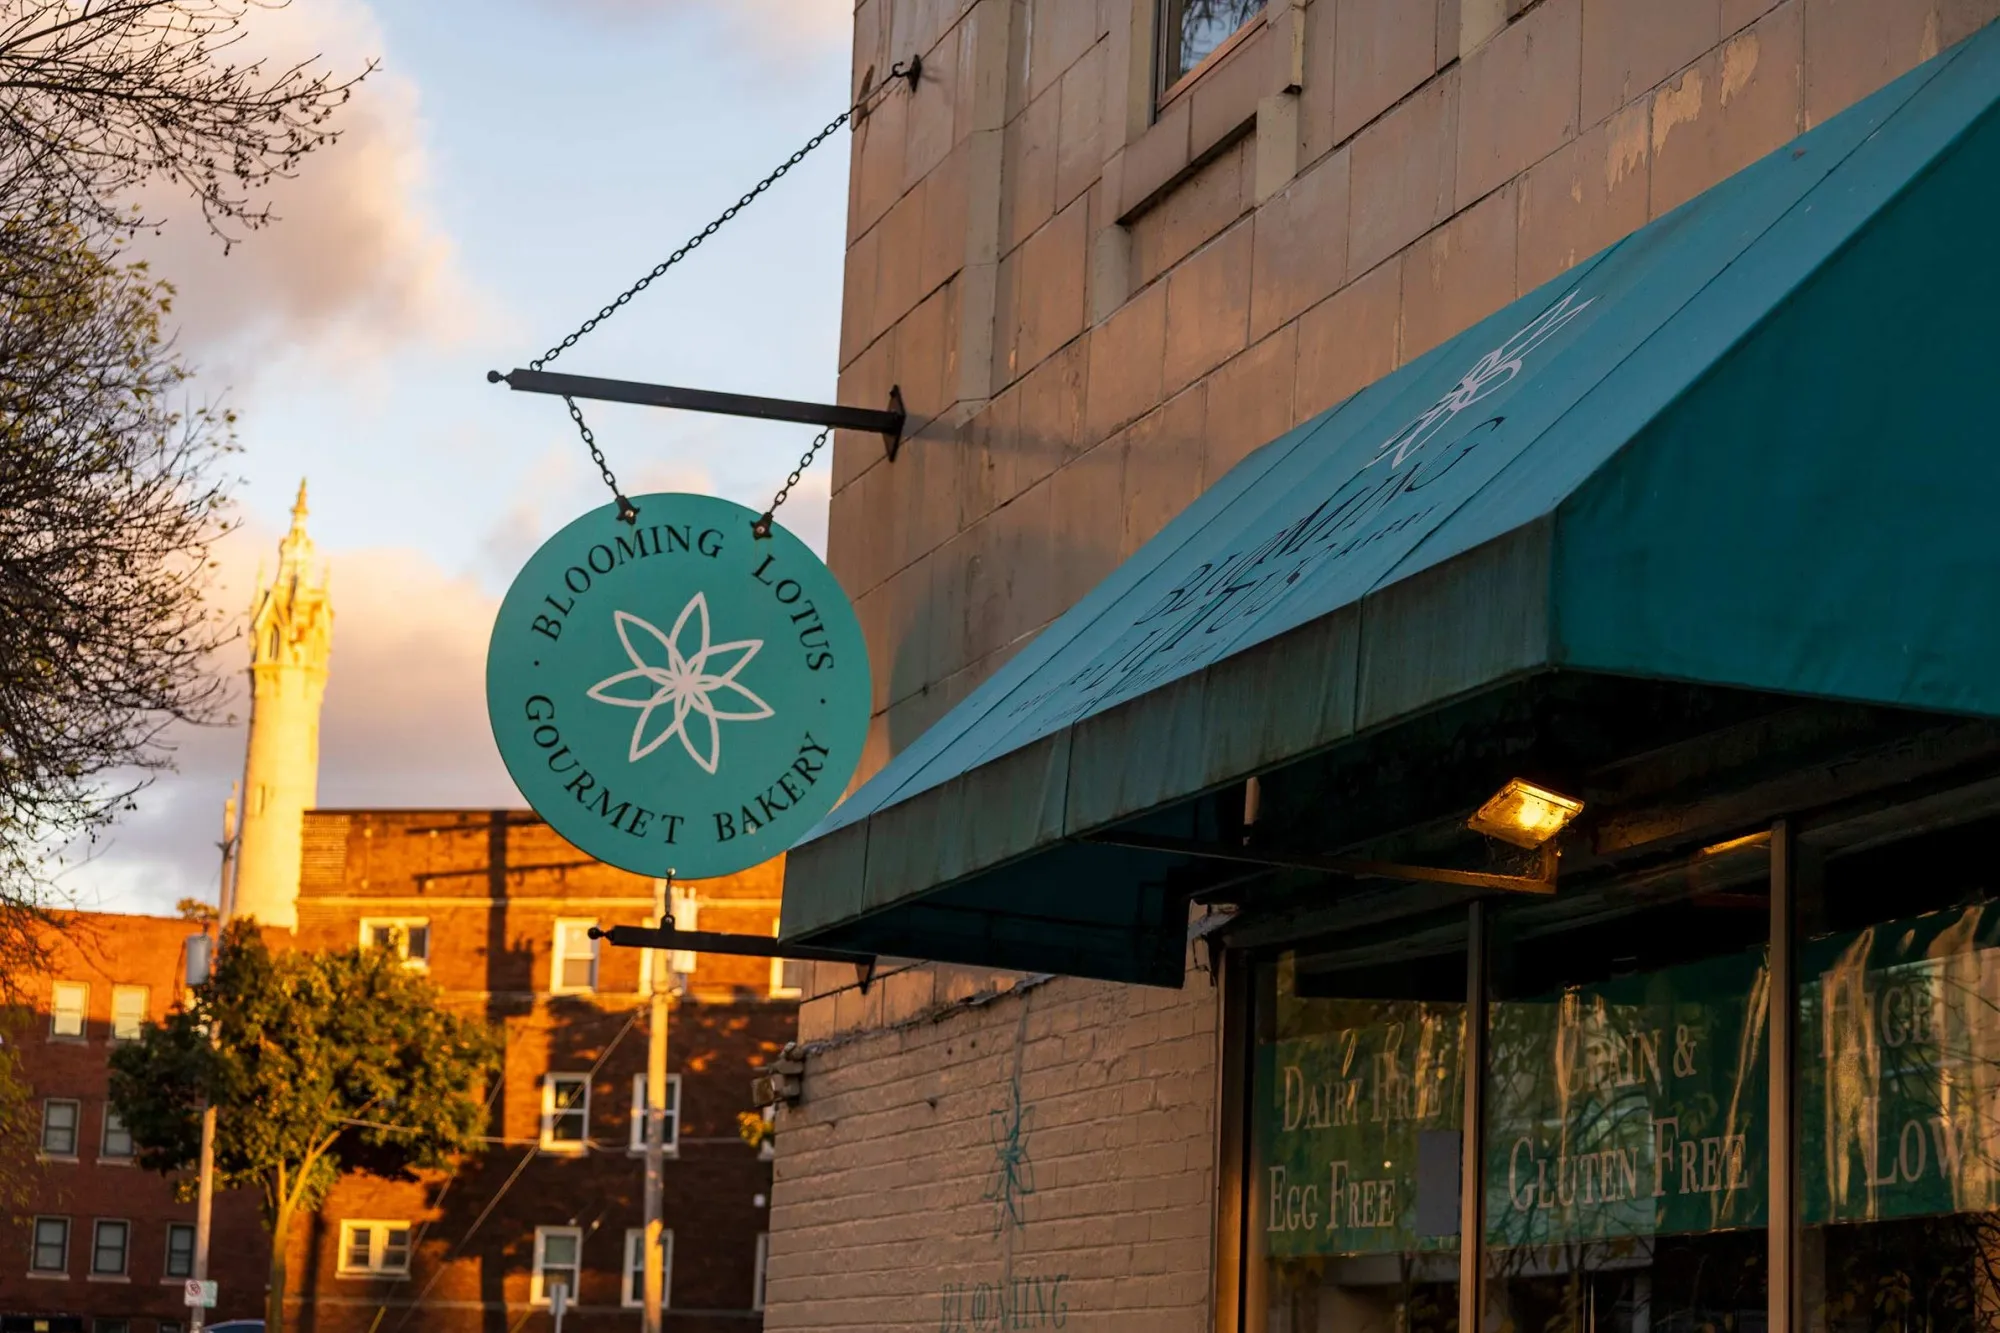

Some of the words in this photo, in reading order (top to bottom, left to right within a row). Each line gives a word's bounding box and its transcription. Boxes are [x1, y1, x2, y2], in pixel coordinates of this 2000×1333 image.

[531, 524, 725, 642] BLOOMING
[751, 554, 835, 673] LOTUS
[524, 694, 685, 845] GOURMET
[712, 731, 830, 843] BAKERY
[1672, 1024, 1698, 1078] &
[1281, 1065, 1364, 1133] DAIRY
[1863, 1096, 1970, 1187] LOW
[1266, 1164, 1319, 1233] EGG
[1326, 1159, 1396, 1231] FREE
[1508, 1135, 1639, 1213] GLUTEN
[1651, 1115, 1749, 1198] FREE
